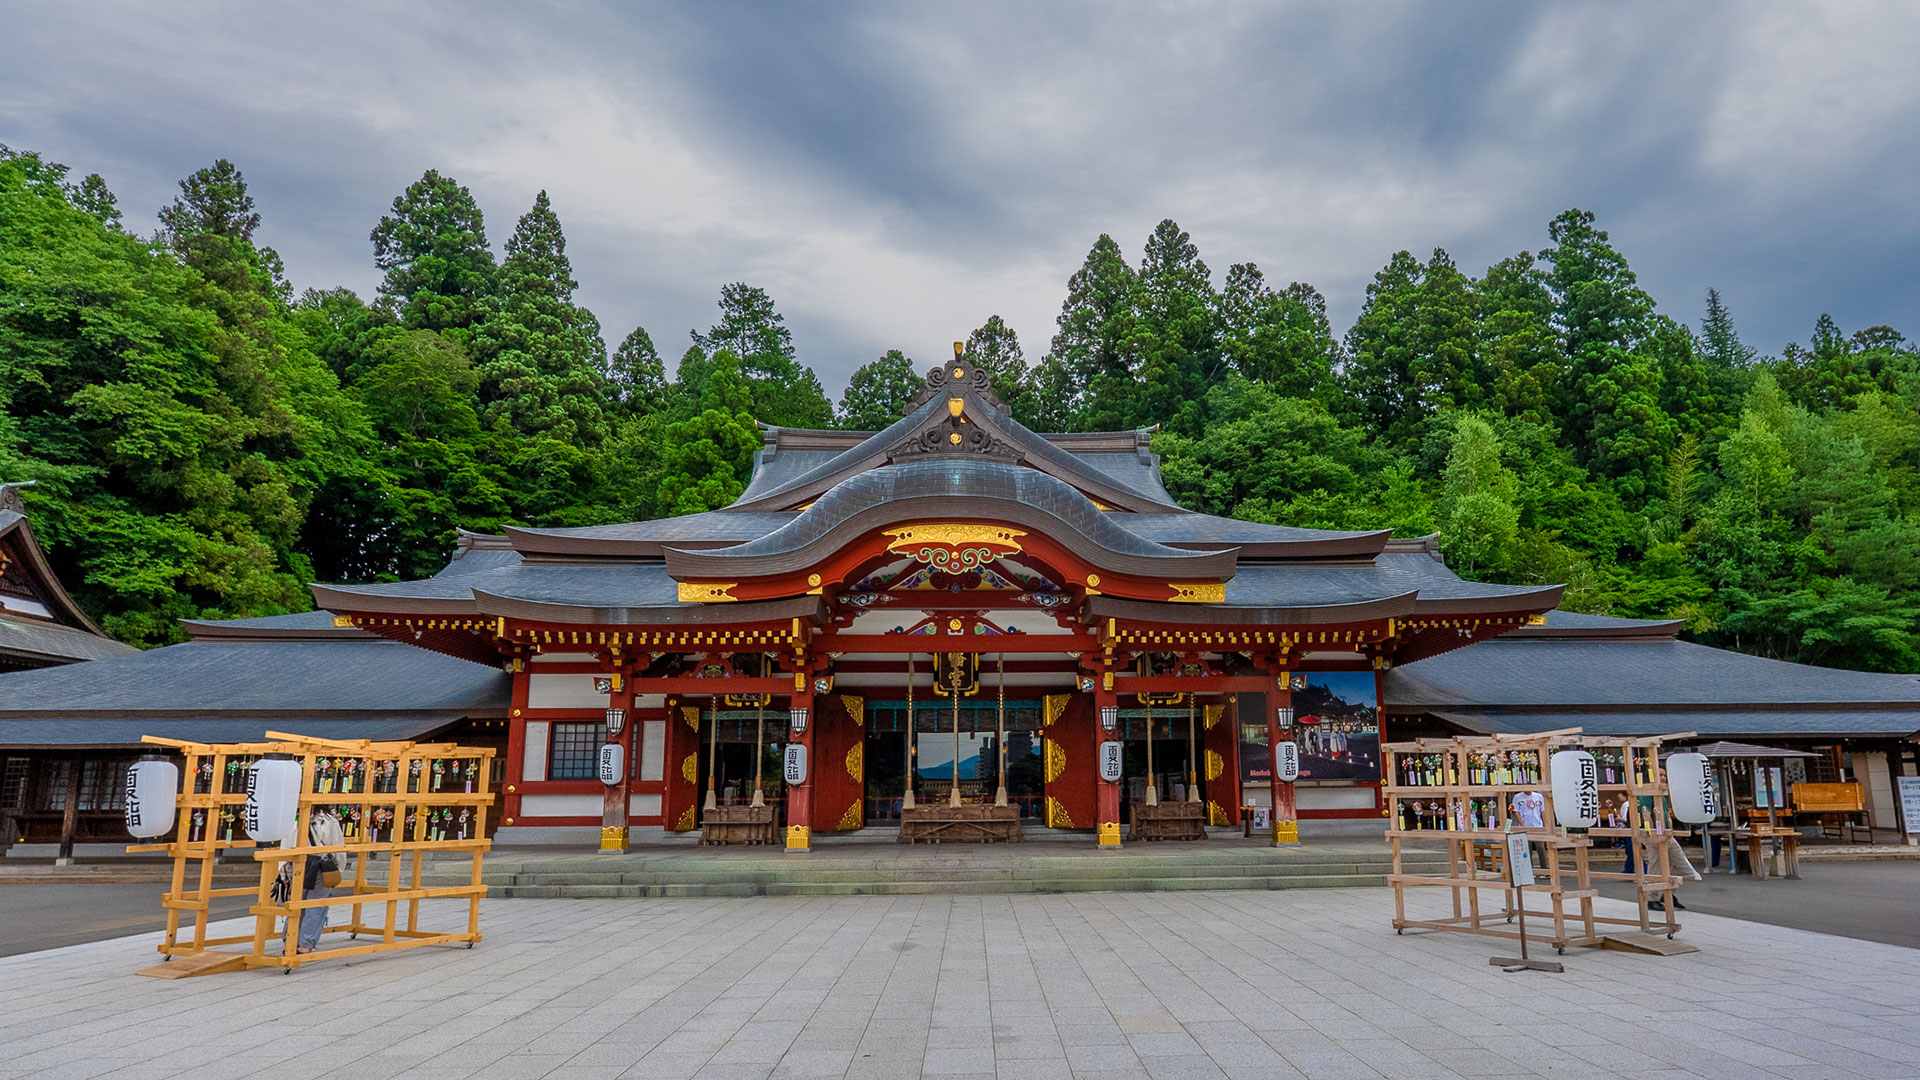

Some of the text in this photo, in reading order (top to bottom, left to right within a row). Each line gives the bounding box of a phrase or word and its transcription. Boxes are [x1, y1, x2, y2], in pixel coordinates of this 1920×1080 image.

[602, 748, 613, 780] 夏詣
[787, 748, 799, 780] 夏詣
[1108, 745, 1119, 776] 夏詣
[1285, 745, 1297, 776] 夏詣
[1578, 758, 1598, 819] 夏詣
